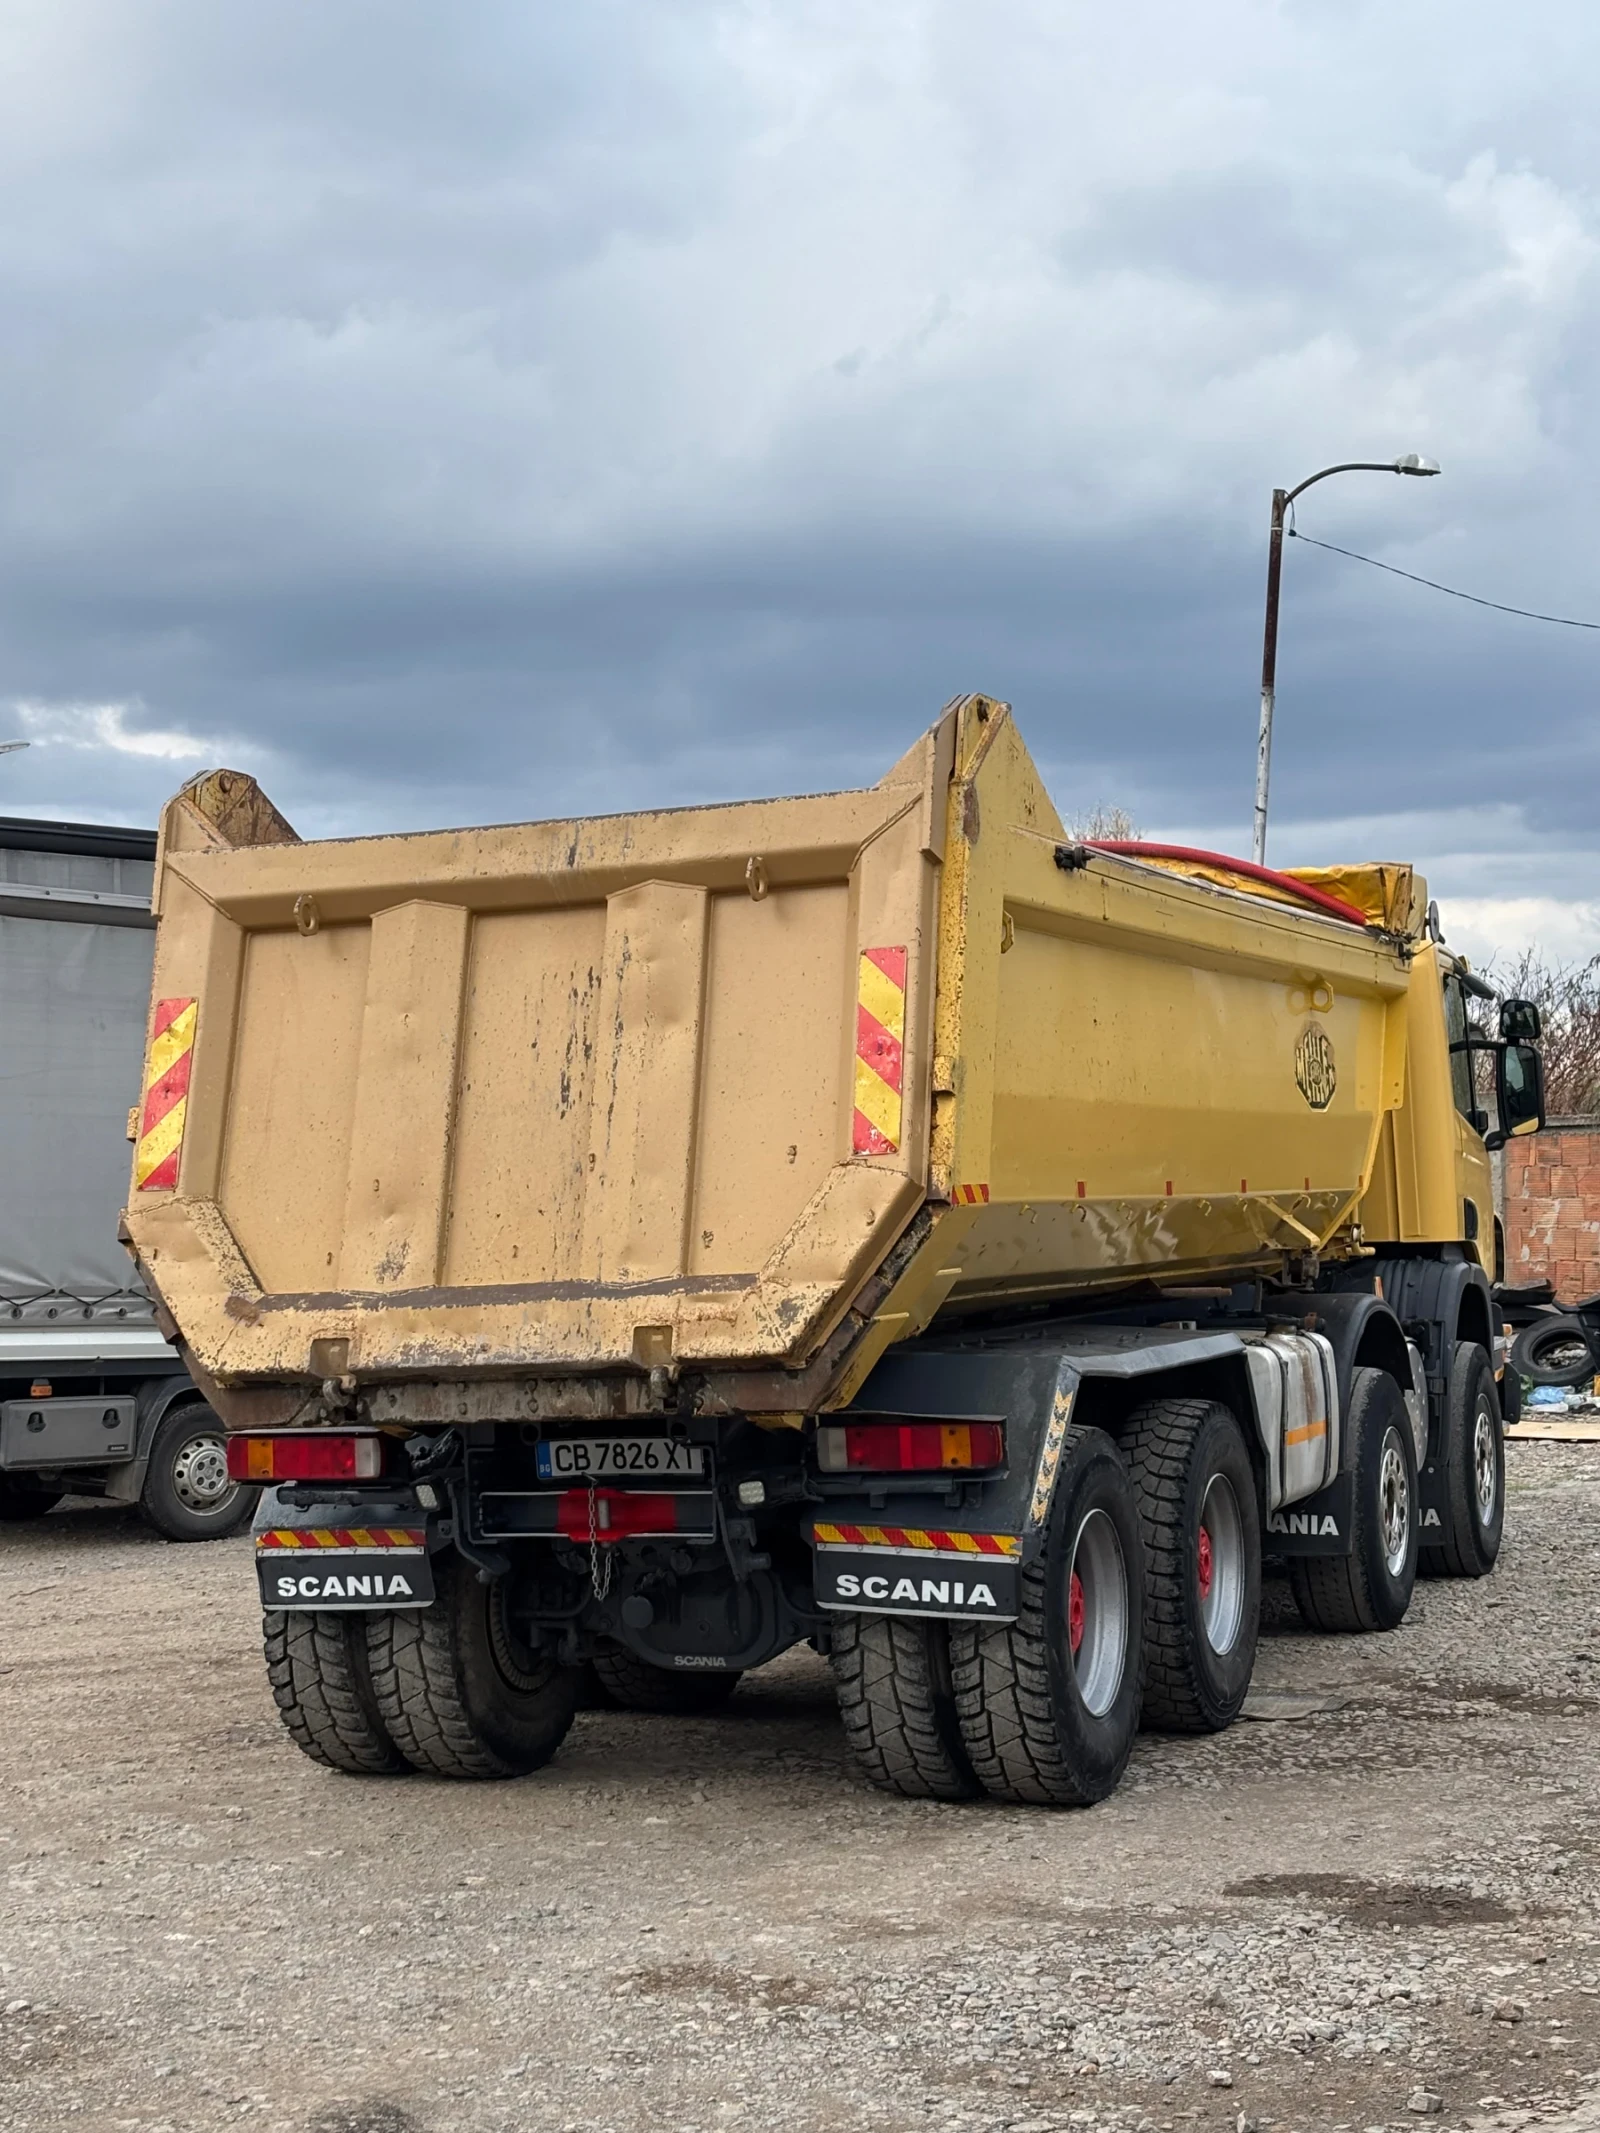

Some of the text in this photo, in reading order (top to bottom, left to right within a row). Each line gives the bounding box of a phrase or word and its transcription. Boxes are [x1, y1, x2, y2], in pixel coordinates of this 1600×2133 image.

[555, 1444, 591, 1471] CB
[595, 1442, 659, 1470] 7826
[539, 1463, 551, 1473] BG
[1272, 1513, 1339, 1536] ANIA
[277, 1575, 413, 1597] SCANIA
[836, 1574, 997, 1607] SCANIA
[674, 1655, 727, 1667] SCANIA
